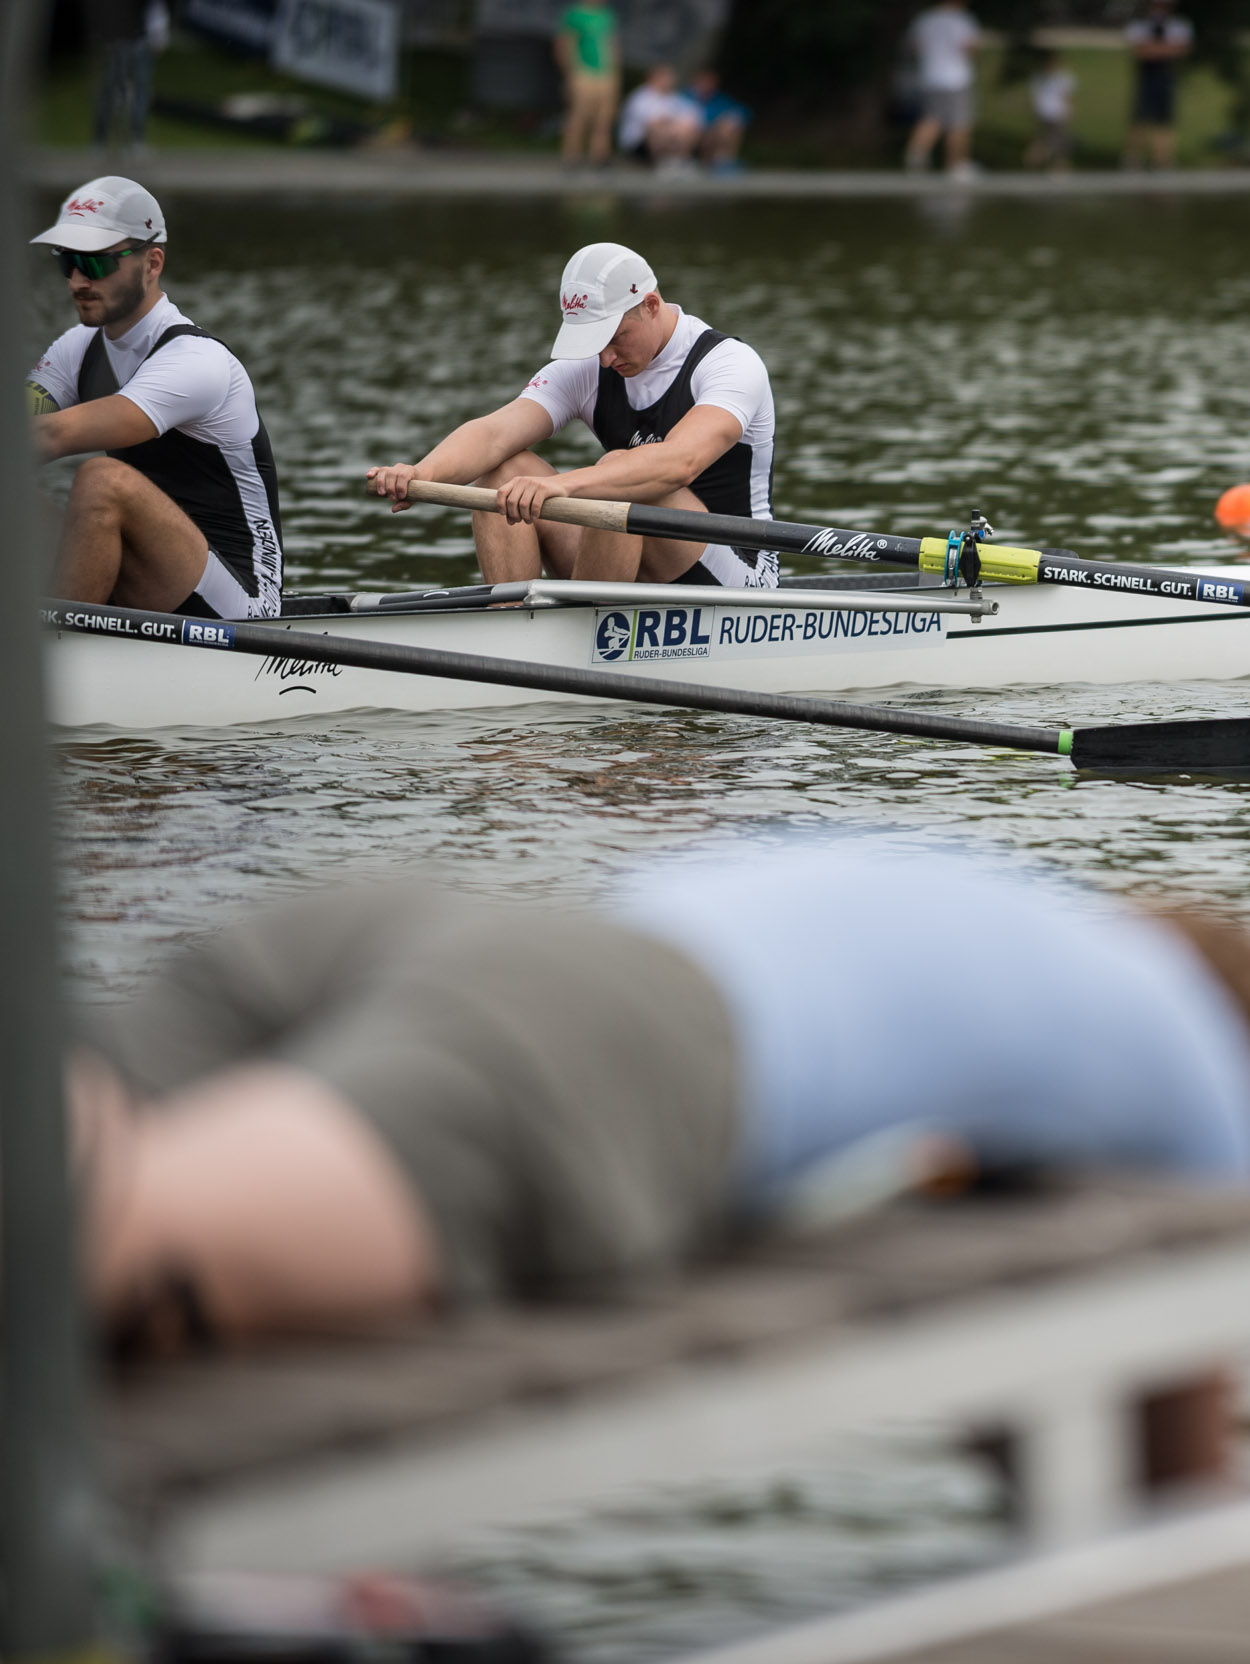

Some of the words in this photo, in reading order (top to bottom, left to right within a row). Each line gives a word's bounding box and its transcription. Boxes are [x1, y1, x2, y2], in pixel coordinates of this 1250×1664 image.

[1043, 566, 1091, 584] STARK.
[1093, 572, 1158, 592] SCHNELL.
[1160, 580, 1192, 596] GUT.
[1203, 583, 1239, 600] RBL
[64, 612, 138, 634] SCHNELL.
[140, 621, 177, 638] GUT.
[189, 624, 229, 643] RBL
[635, 608, 710, 648] RBL
[719, 610, 942, 645] RUDER-BUNDESLIGA
[633, 647, 708, 659] RUDER-BUNDESLIGA
